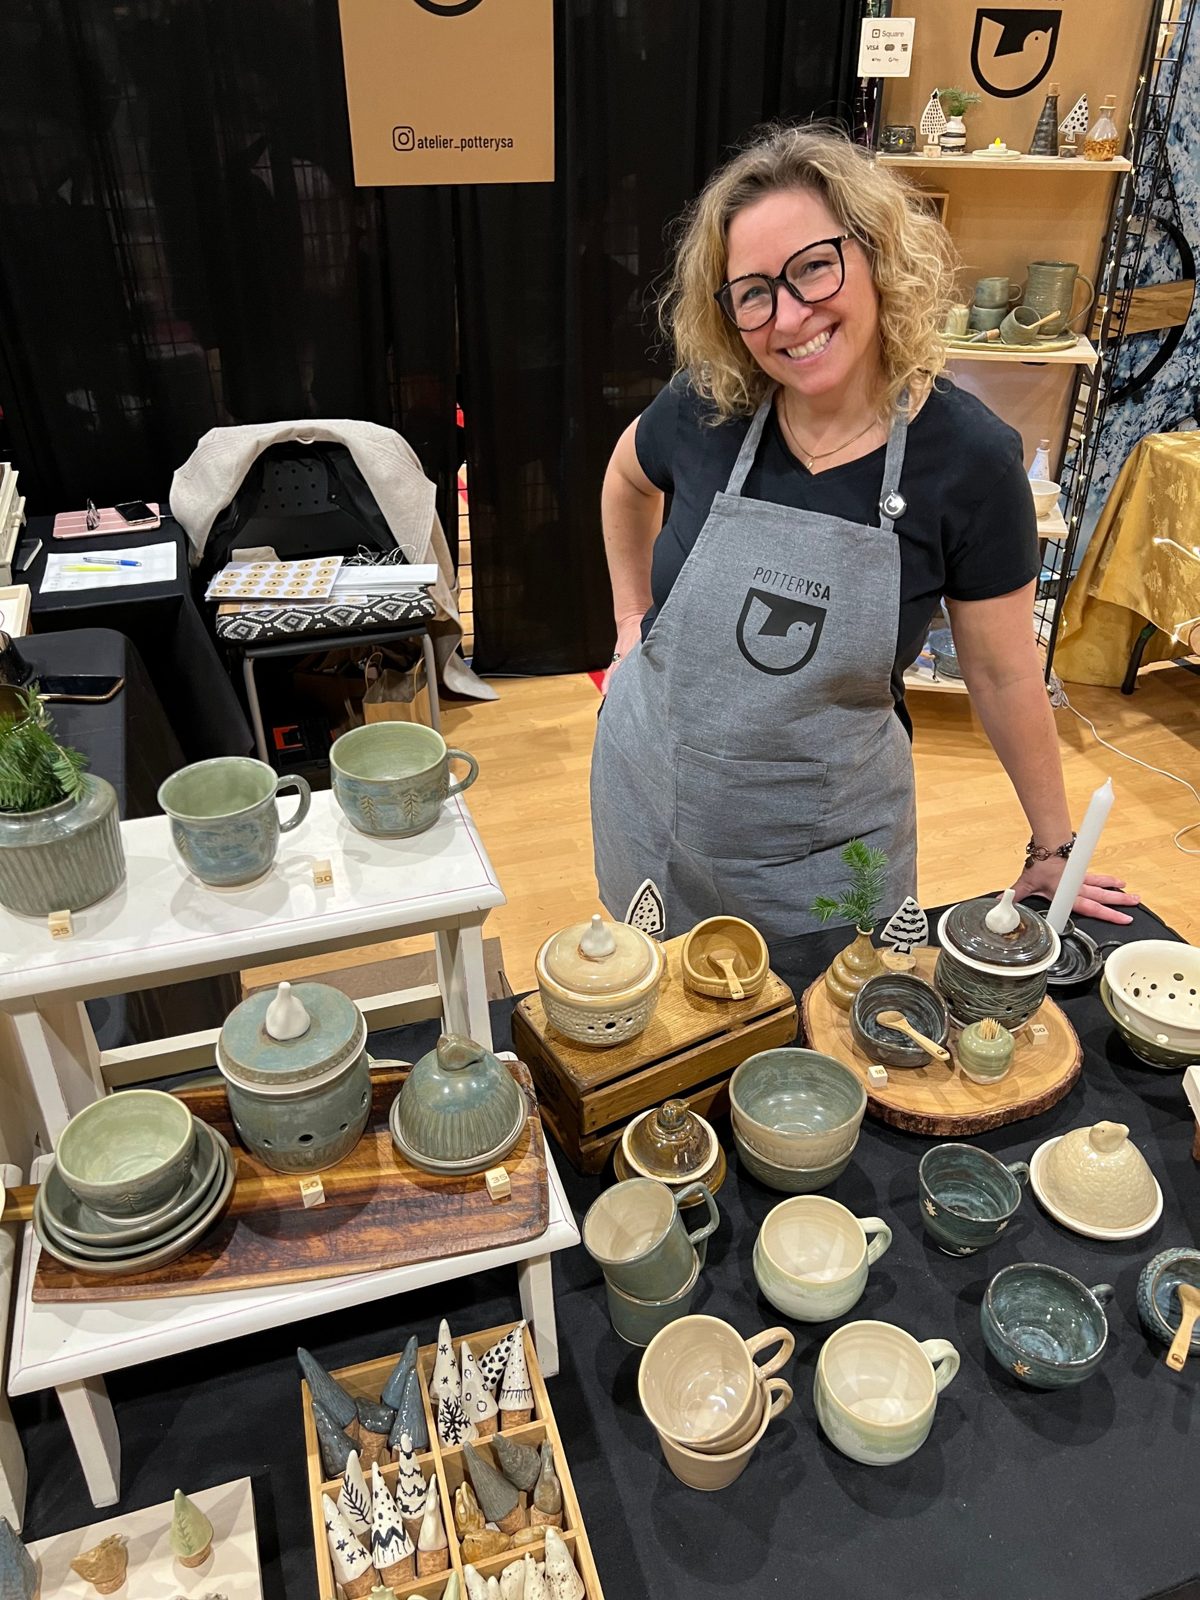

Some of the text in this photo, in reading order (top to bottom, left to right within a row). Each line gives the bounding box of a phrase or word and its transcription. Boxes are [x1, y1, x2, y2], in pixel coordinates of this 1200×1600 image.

[881, 30, 905, 39] Square
[417, 135, 514, 152] atelier_potterysa
[753, 566, 831, 601] POTTERYSA
[315, 875, 332, 884] 30
[52, 927, 70, 937] 25
[491, 1173, 508, 1184] 35
